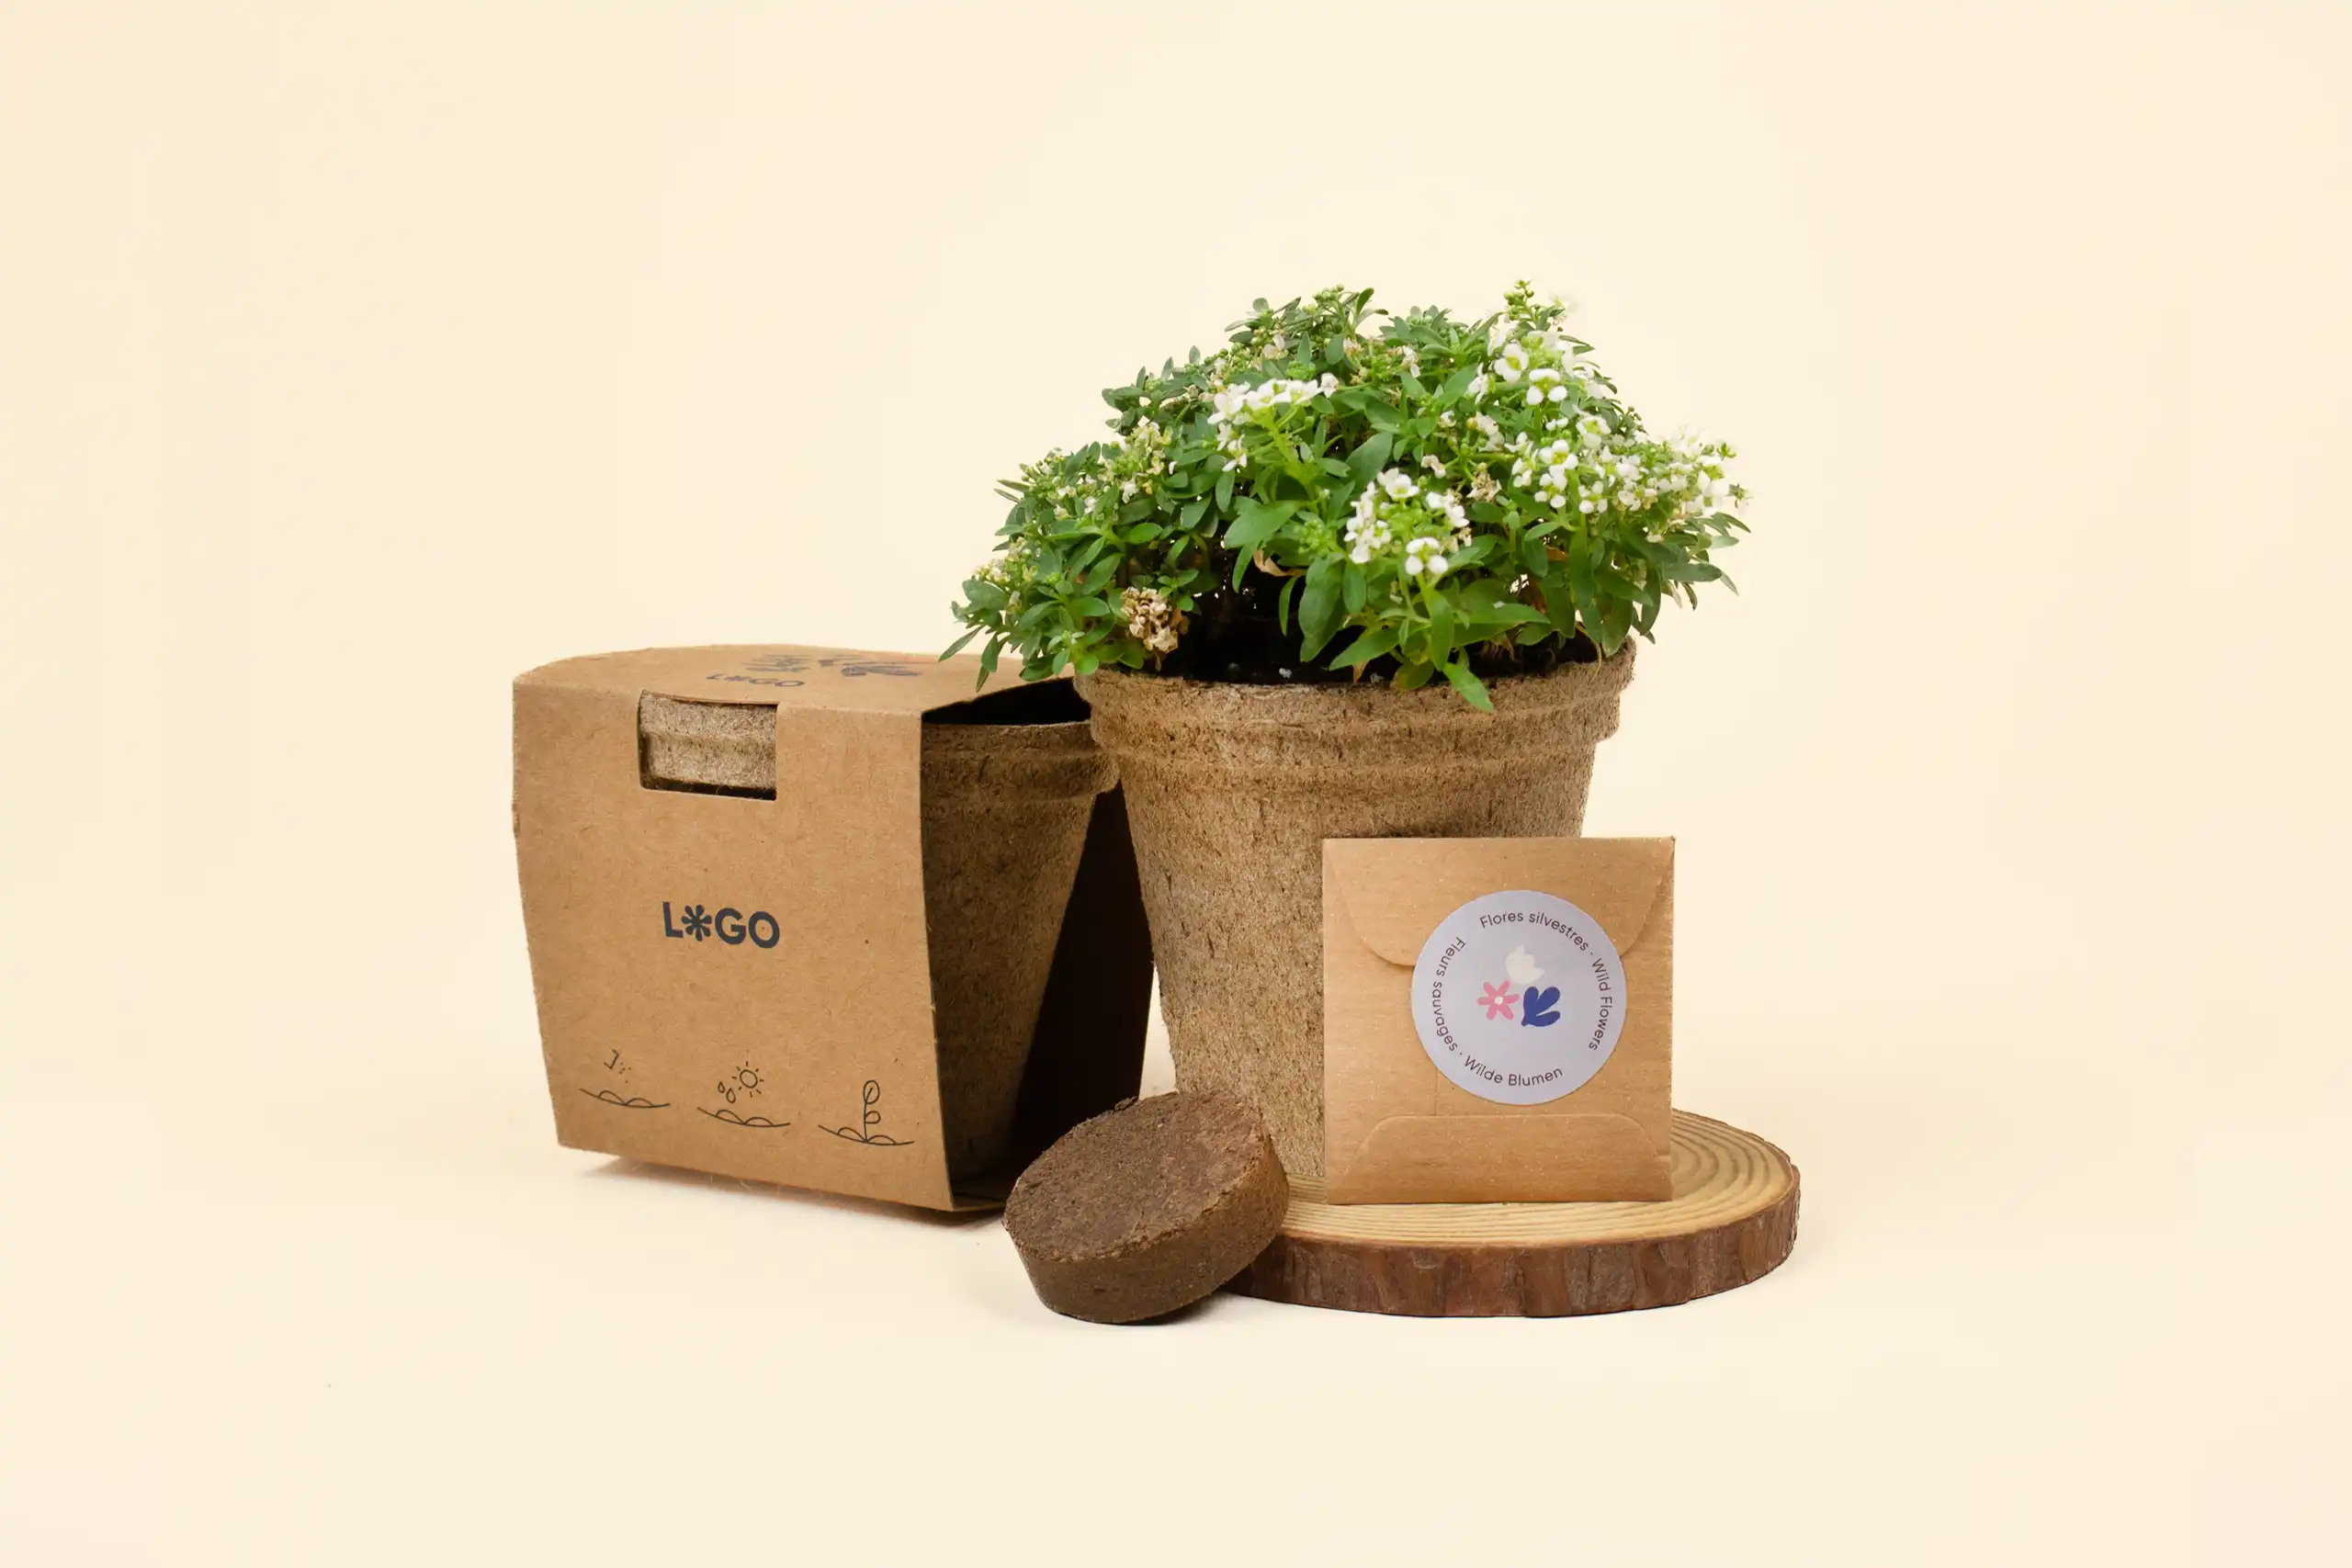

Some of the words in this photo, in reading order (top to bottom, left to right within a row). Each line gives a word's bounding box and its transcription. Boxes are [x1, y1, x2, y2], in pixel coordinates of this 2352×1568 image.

[1479, 911, 1524, 929] Flores
[1528, 911, 1589, 952] silvestres
[1436, 936, 1466, 977] Fleurs
[1591, 958, 1611, 992] Wild
[1431, 981, 1458, 1052] sauvages
[1589, 996, 1612, 1051] Flowers
[1464, 1055, 1503, 1084] Wilde
[1508, 1067, 1564, 1087] Blumen
